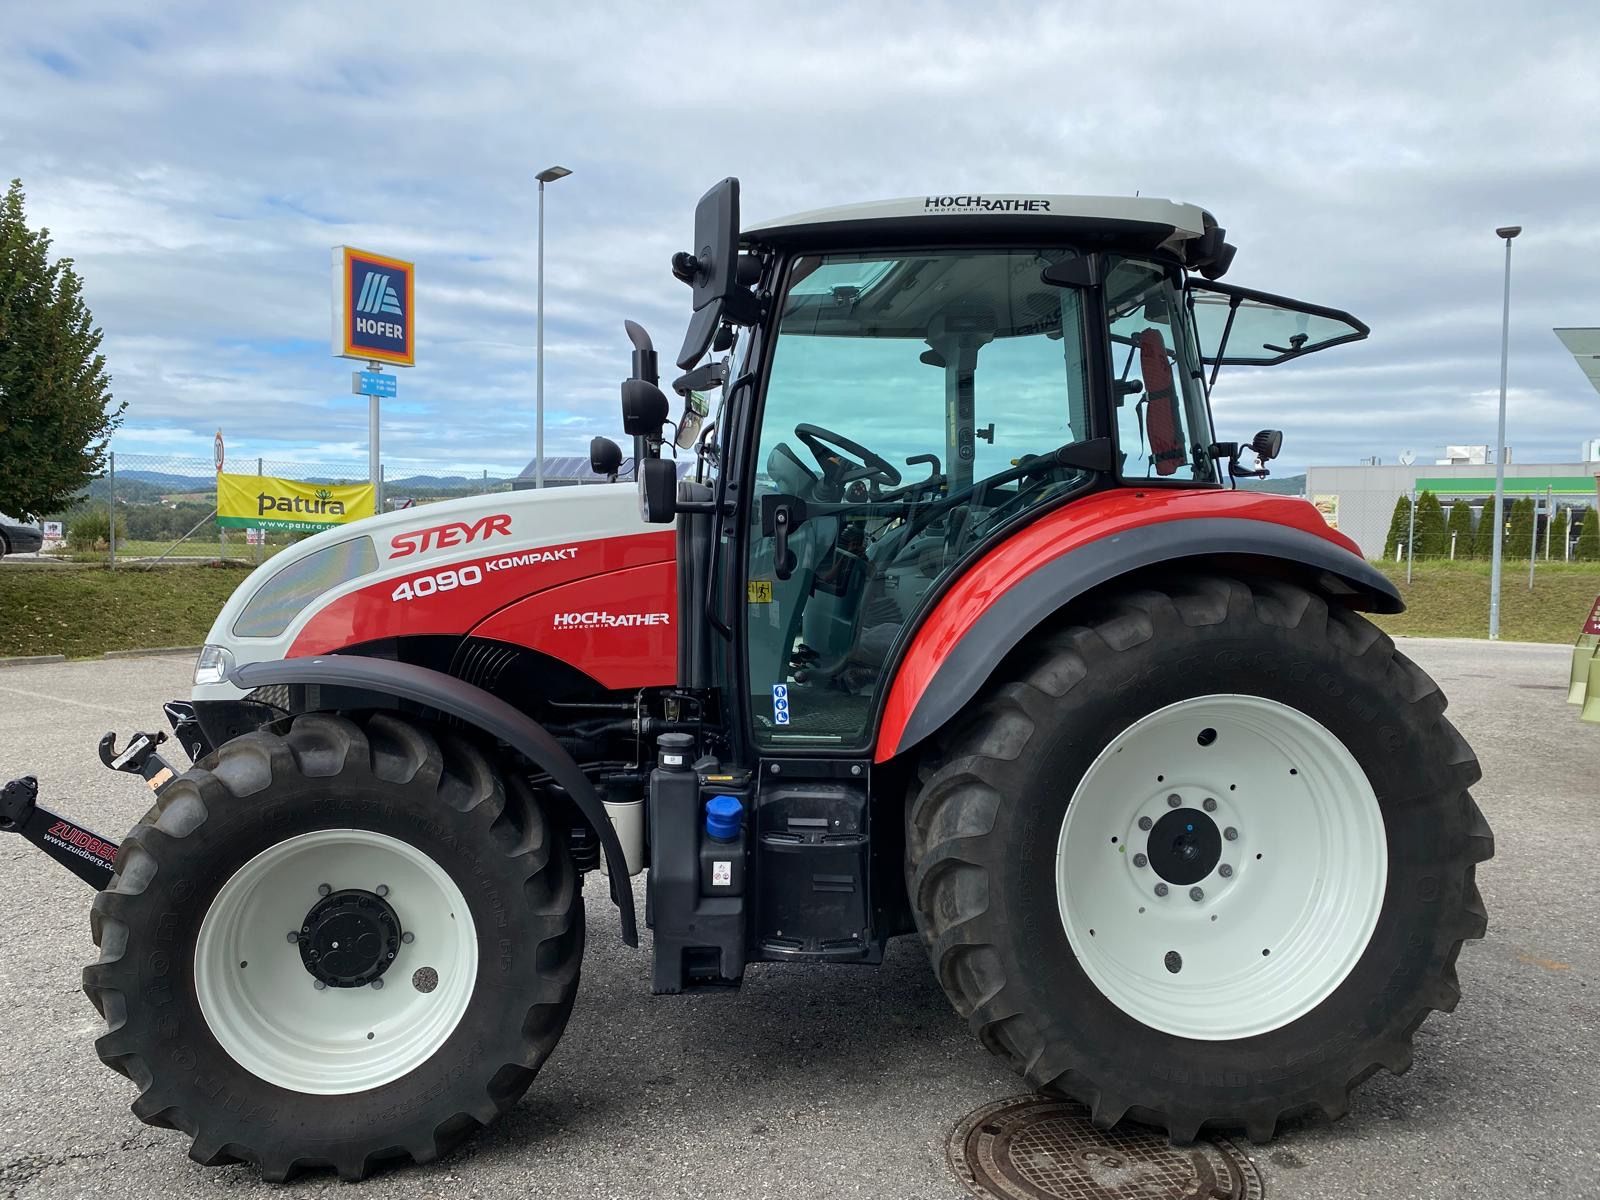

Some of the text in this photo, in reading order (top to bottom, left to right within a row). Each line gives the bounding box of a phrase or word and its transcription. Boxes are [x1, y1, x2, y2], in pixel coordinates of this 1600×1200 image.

[925, 196, 1050, 211] HOCHRATHER
[356, 317, 402, 340] HOFER
[257, 491, 345, 515] patura
[258, 520, 336, 530] www.patura.co
[389, 514, 512, 559] STEYR
[391, 547, 578, 602] 4090 KOMPAKT
[554, 611, 670, 627] HOCHRATHER
[43, 833, 116, 873] www.zuidberg.co
[48, 821, 118, 863] ZUIDBER
